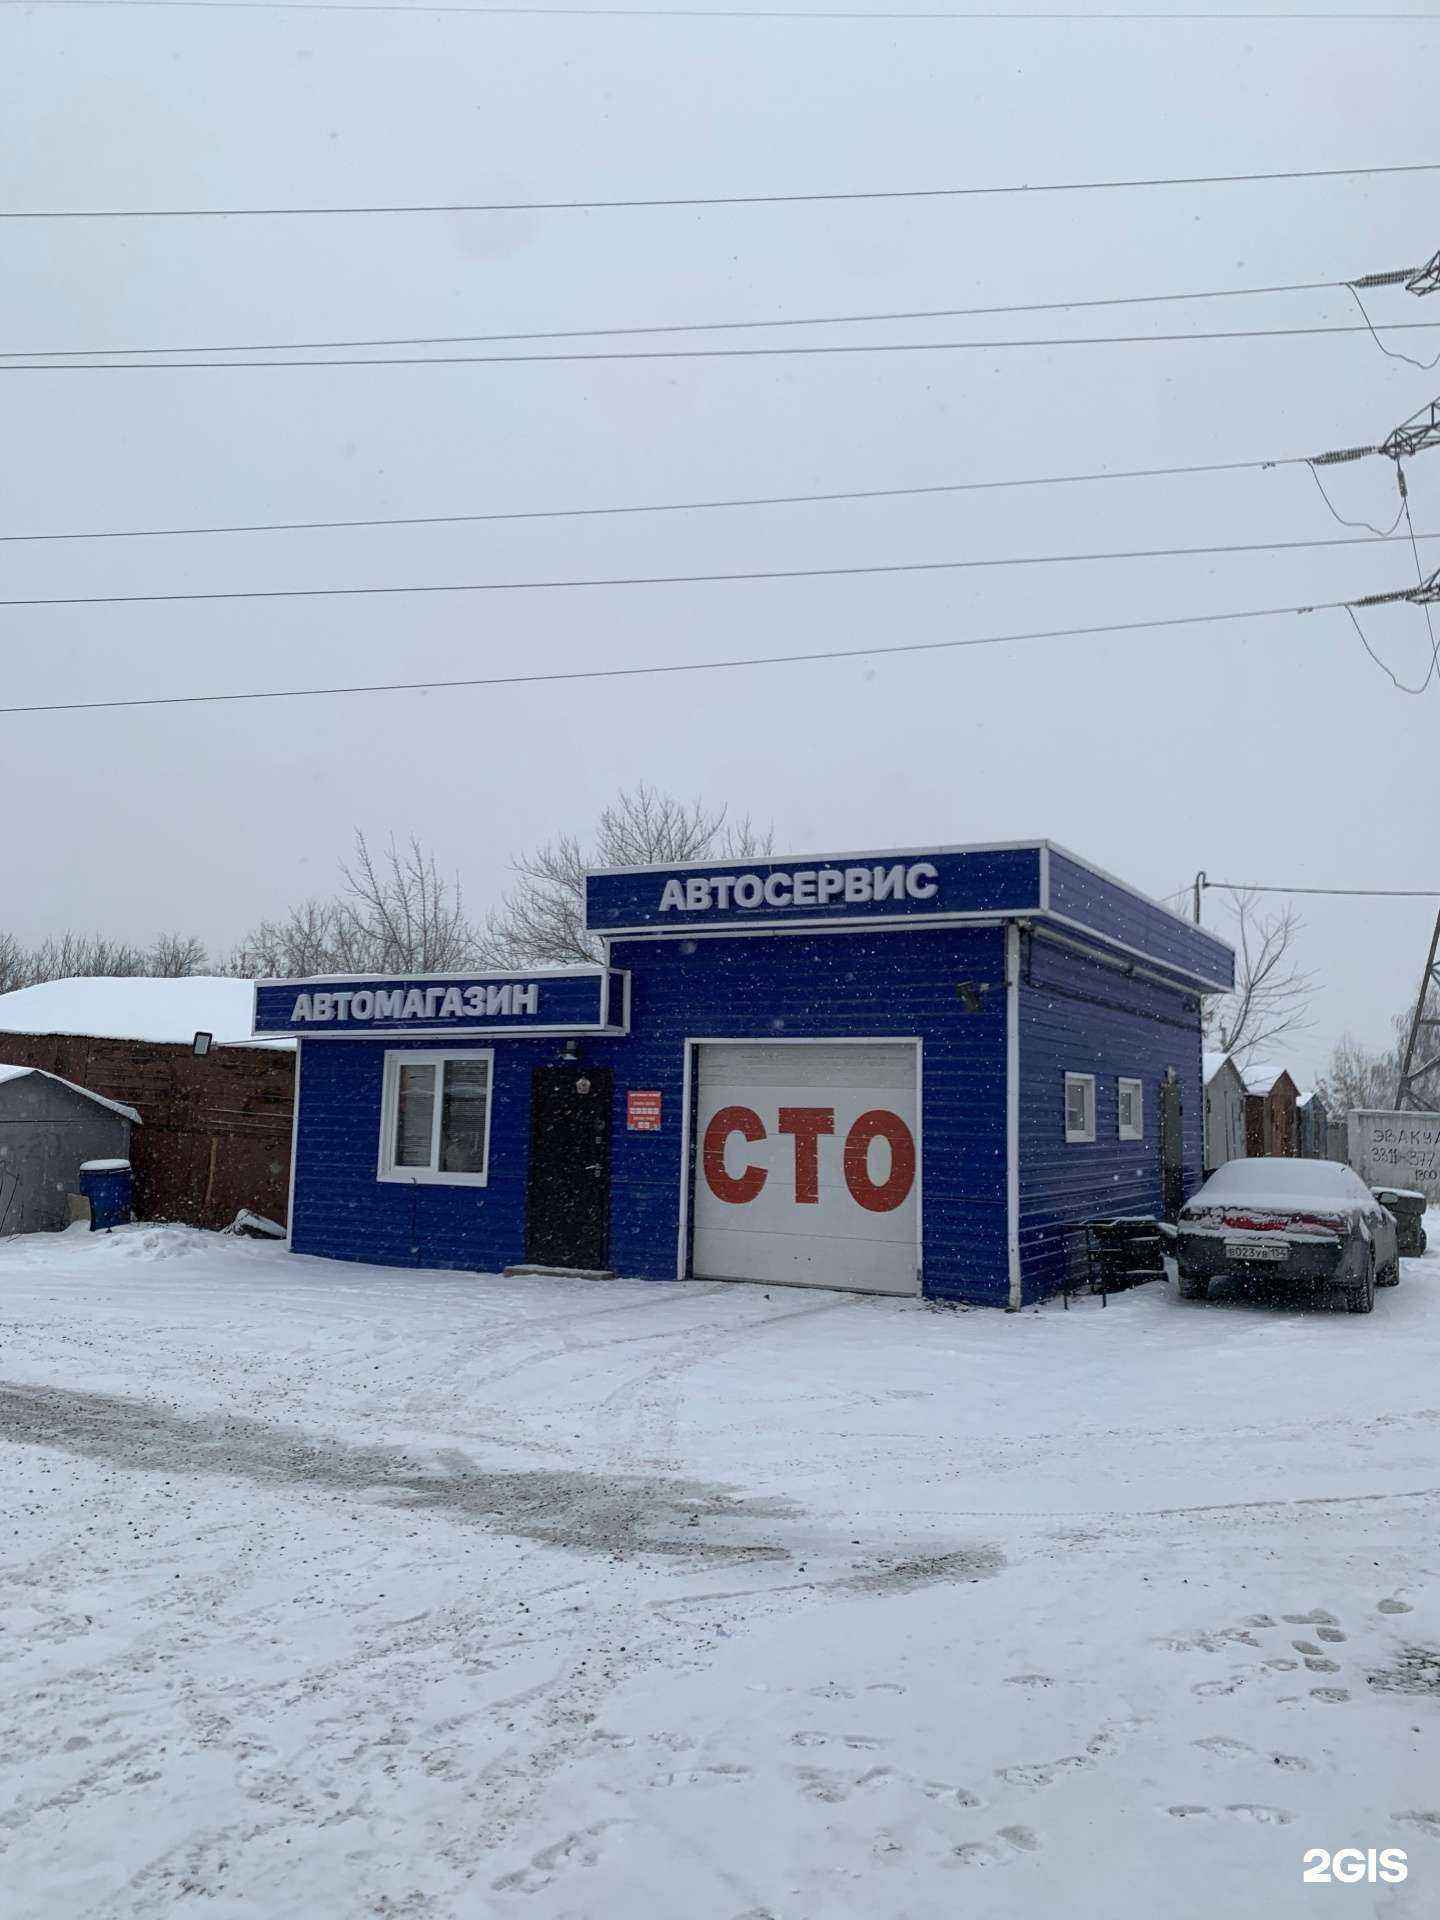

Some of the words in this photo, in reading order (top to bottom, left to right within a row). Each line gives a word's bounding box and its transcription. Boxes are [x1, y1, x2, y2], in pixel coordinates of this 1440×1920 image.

[658, 862, 939, 912] АВТОСЕРВИС
[290, 984, 539, 1022] АВТОМАГАЗИН
[703, 1105, 916, 1213] СТО
